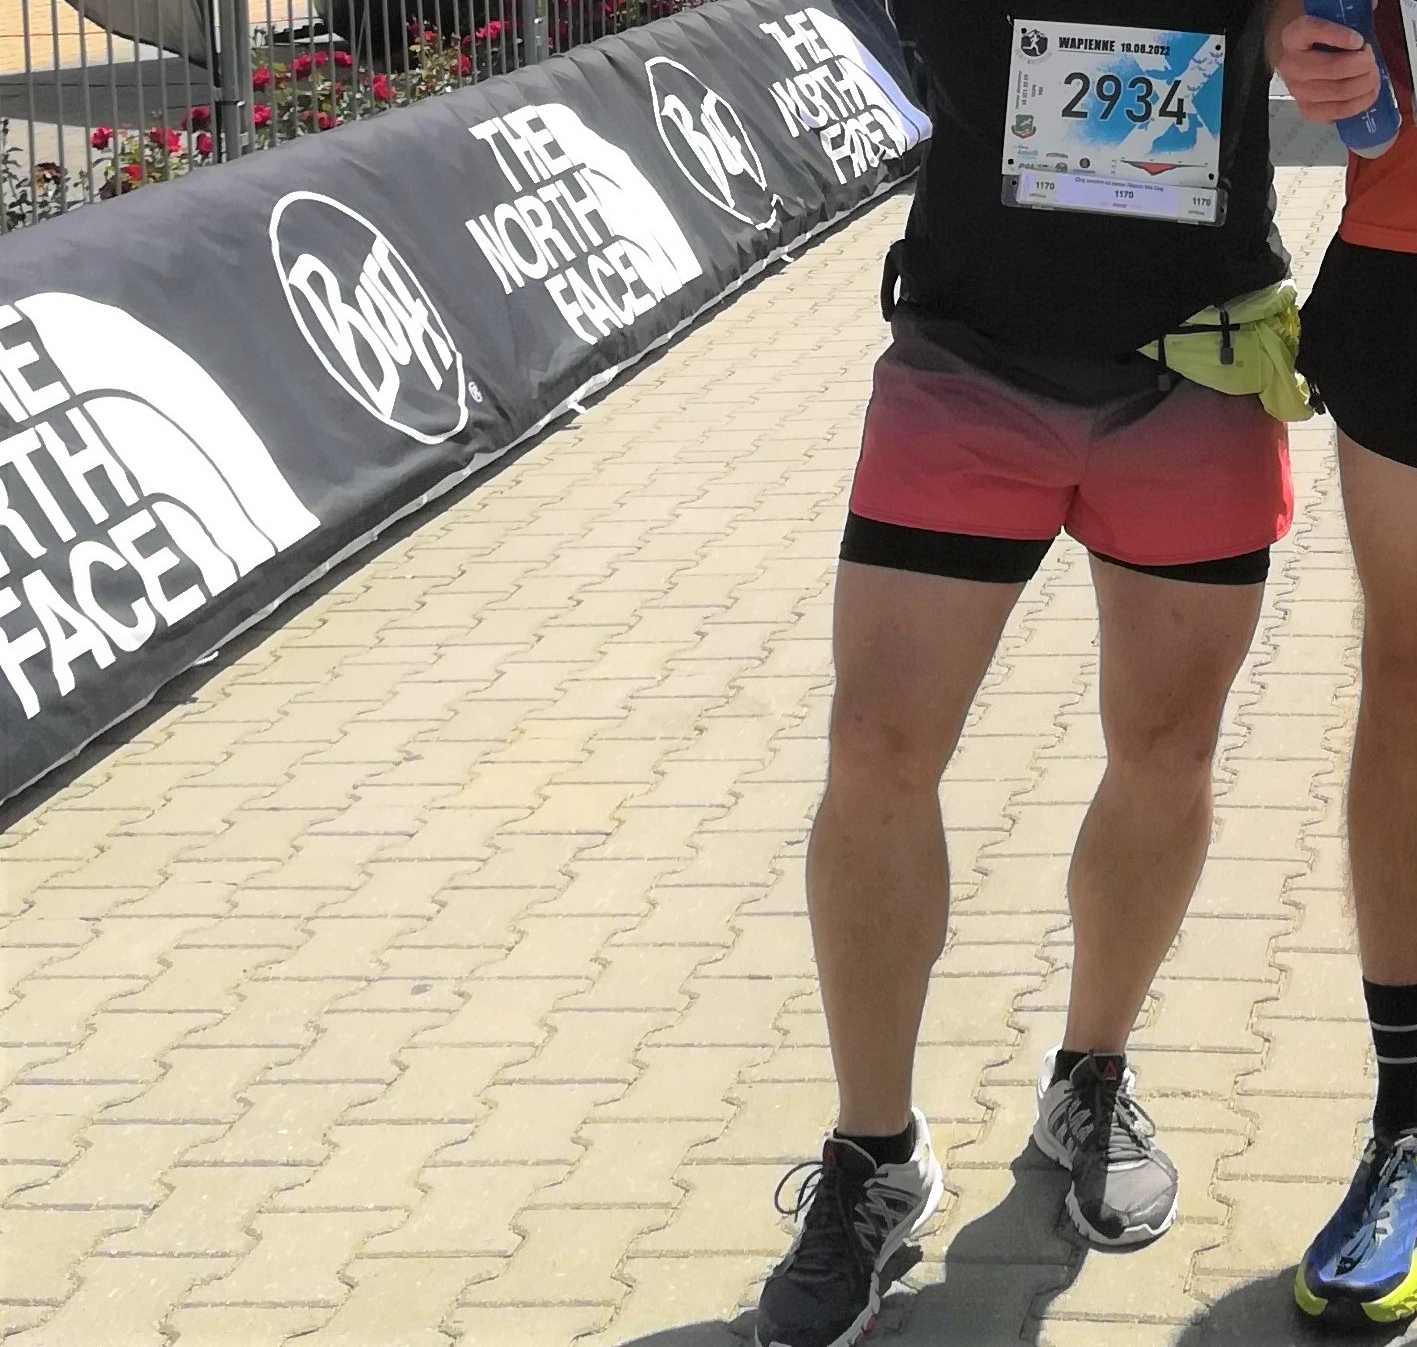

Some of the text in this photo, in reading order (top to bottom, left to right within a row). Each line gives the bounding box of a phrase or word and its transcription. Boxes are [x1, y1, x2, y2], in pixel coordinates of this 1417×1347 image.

[1058, 36, 1115, 52] WAPIENNE
[1061, 72, 1187, 126] 2934
[468, 104, 575, 194] THE
[1114, 189, 1135, 199] 1170
[464, 166, 617, 296] NORTH
[543, 239, 659, 346] FACE
